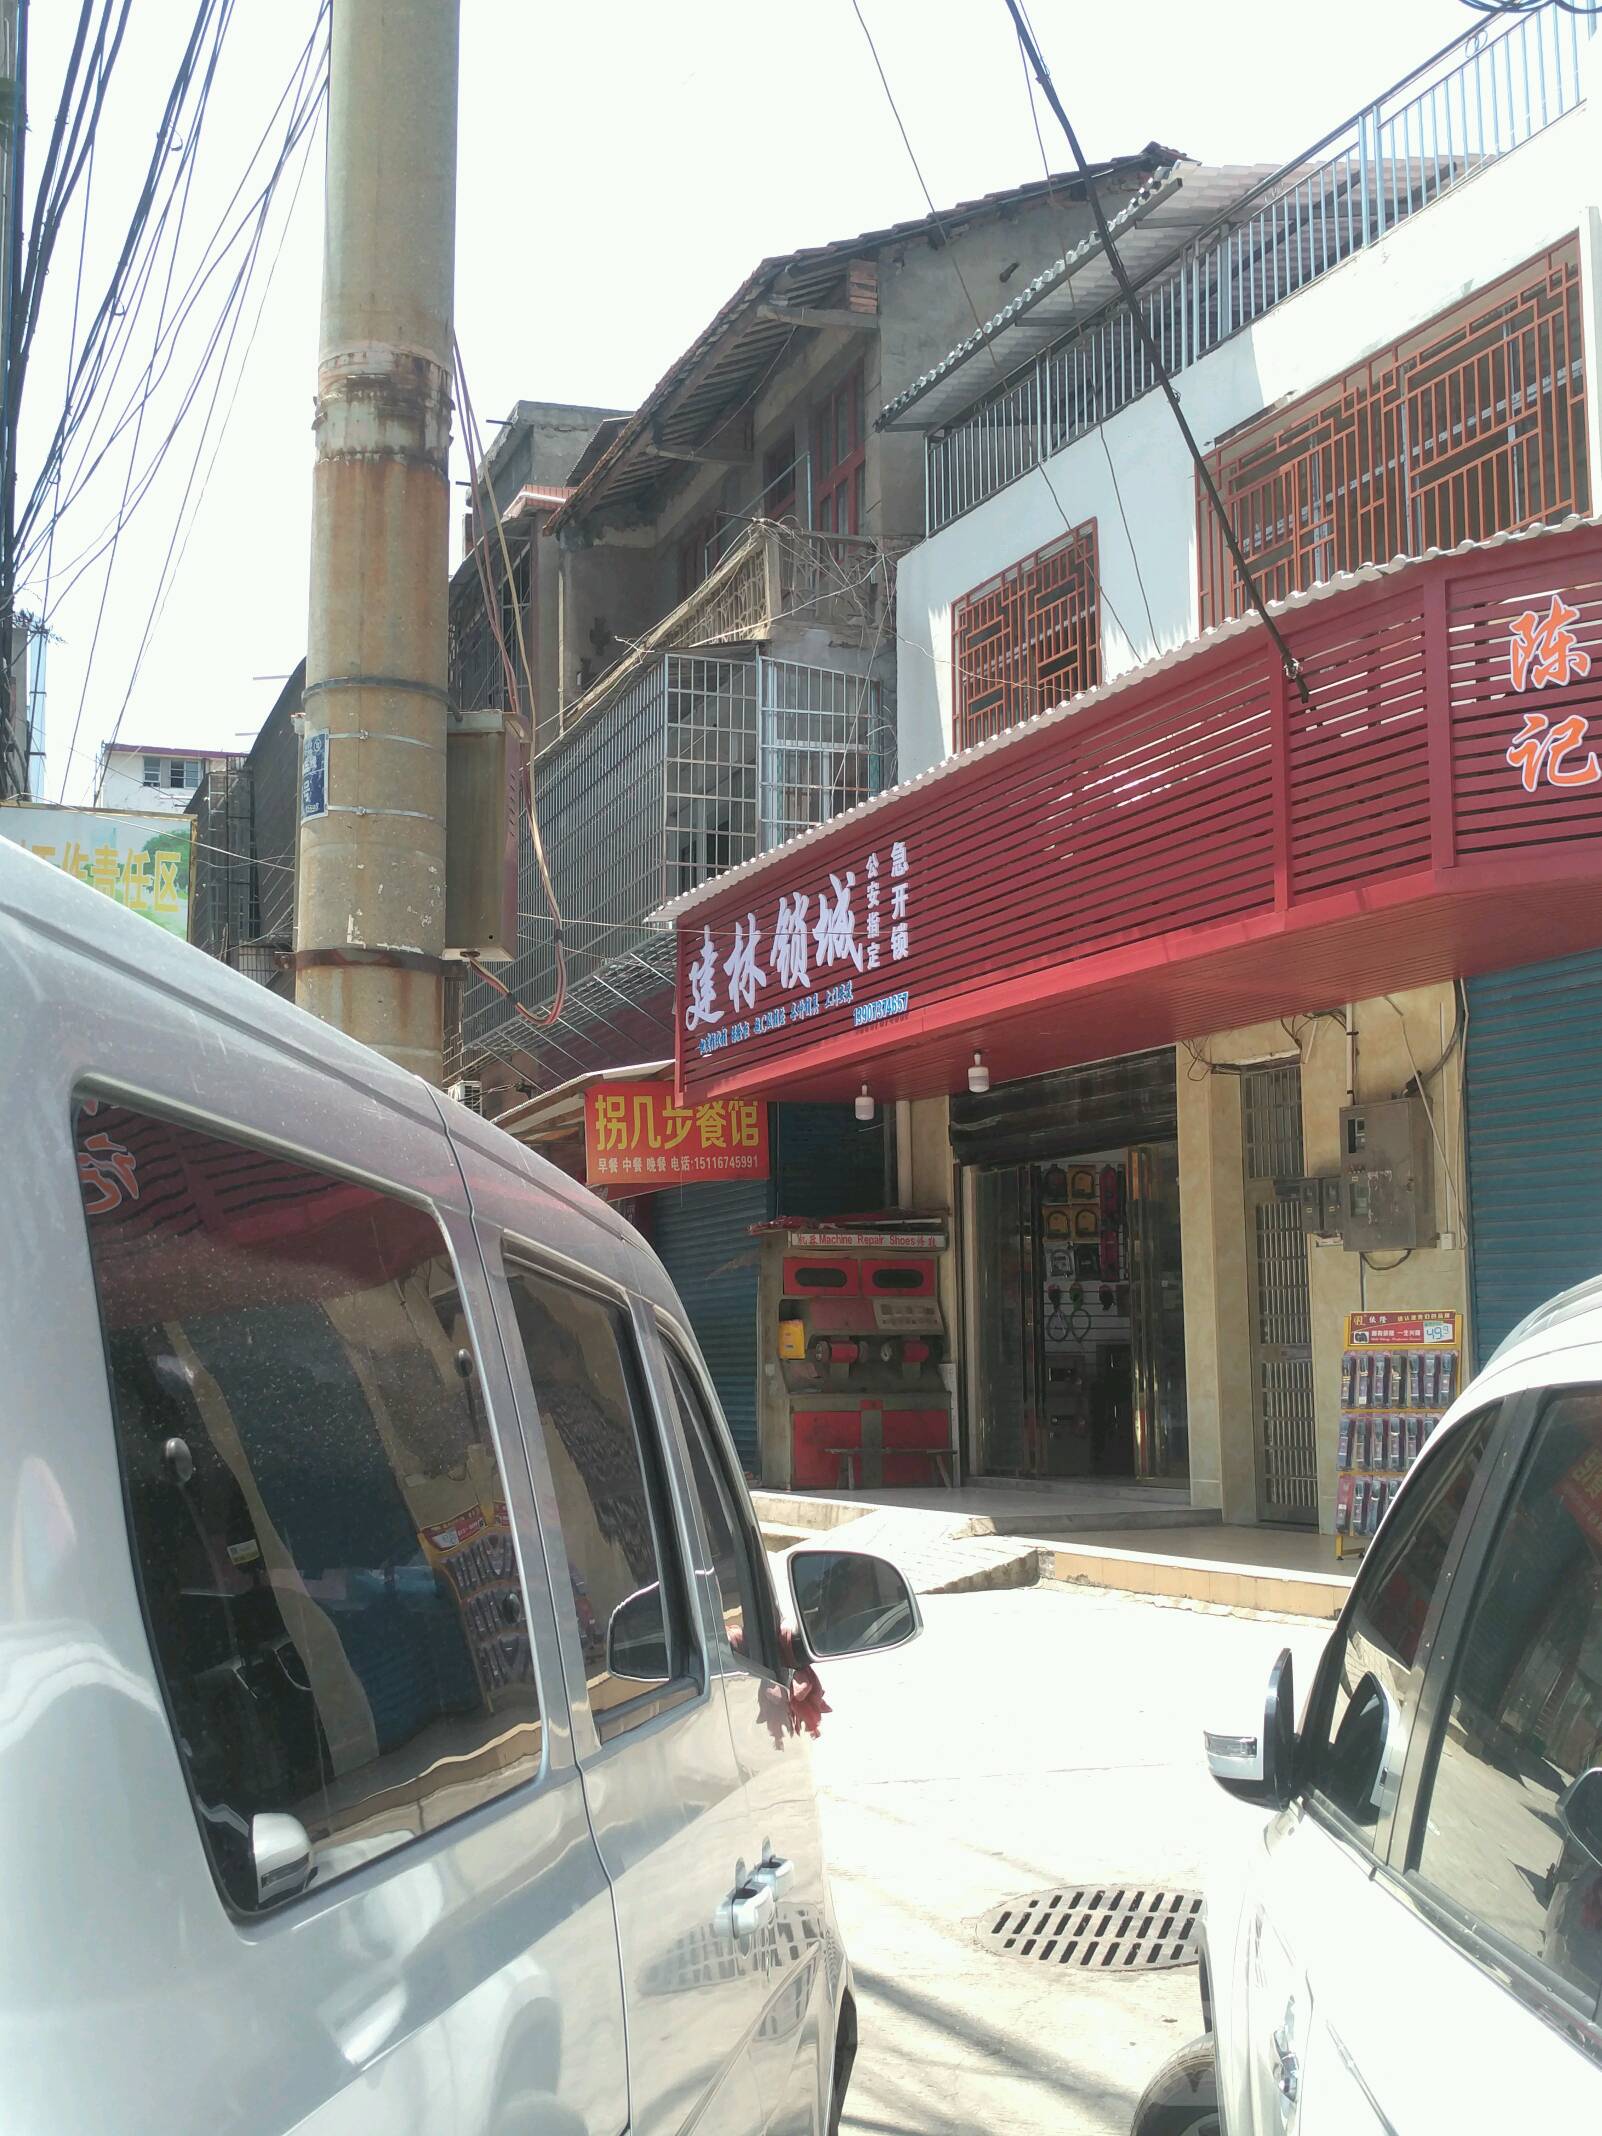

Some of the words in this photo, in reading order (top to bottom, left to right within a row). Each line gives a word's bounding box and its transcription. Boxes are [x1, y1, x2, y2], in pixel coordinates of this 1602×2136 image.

[1507, 595, 1602, 793] 陈记
[685, 871, 864, 1031] 建林锁城
[865, 852, 881, 970] 公安指定
[890, 841, 910, 961] 急开锁
[595, 1094, 759, 1151] 拐几步餐馆
[598, 1157, 619, 1173] 早餐
[622, 1156, 642, 1173] 中餐
[646, 1156, 667, 1173] 晚餐
[819, 1234, 852, 1245] Machine
[857, 1234, 884, 1246] Repair
[889, 1234, 915, 1245] Shoes
